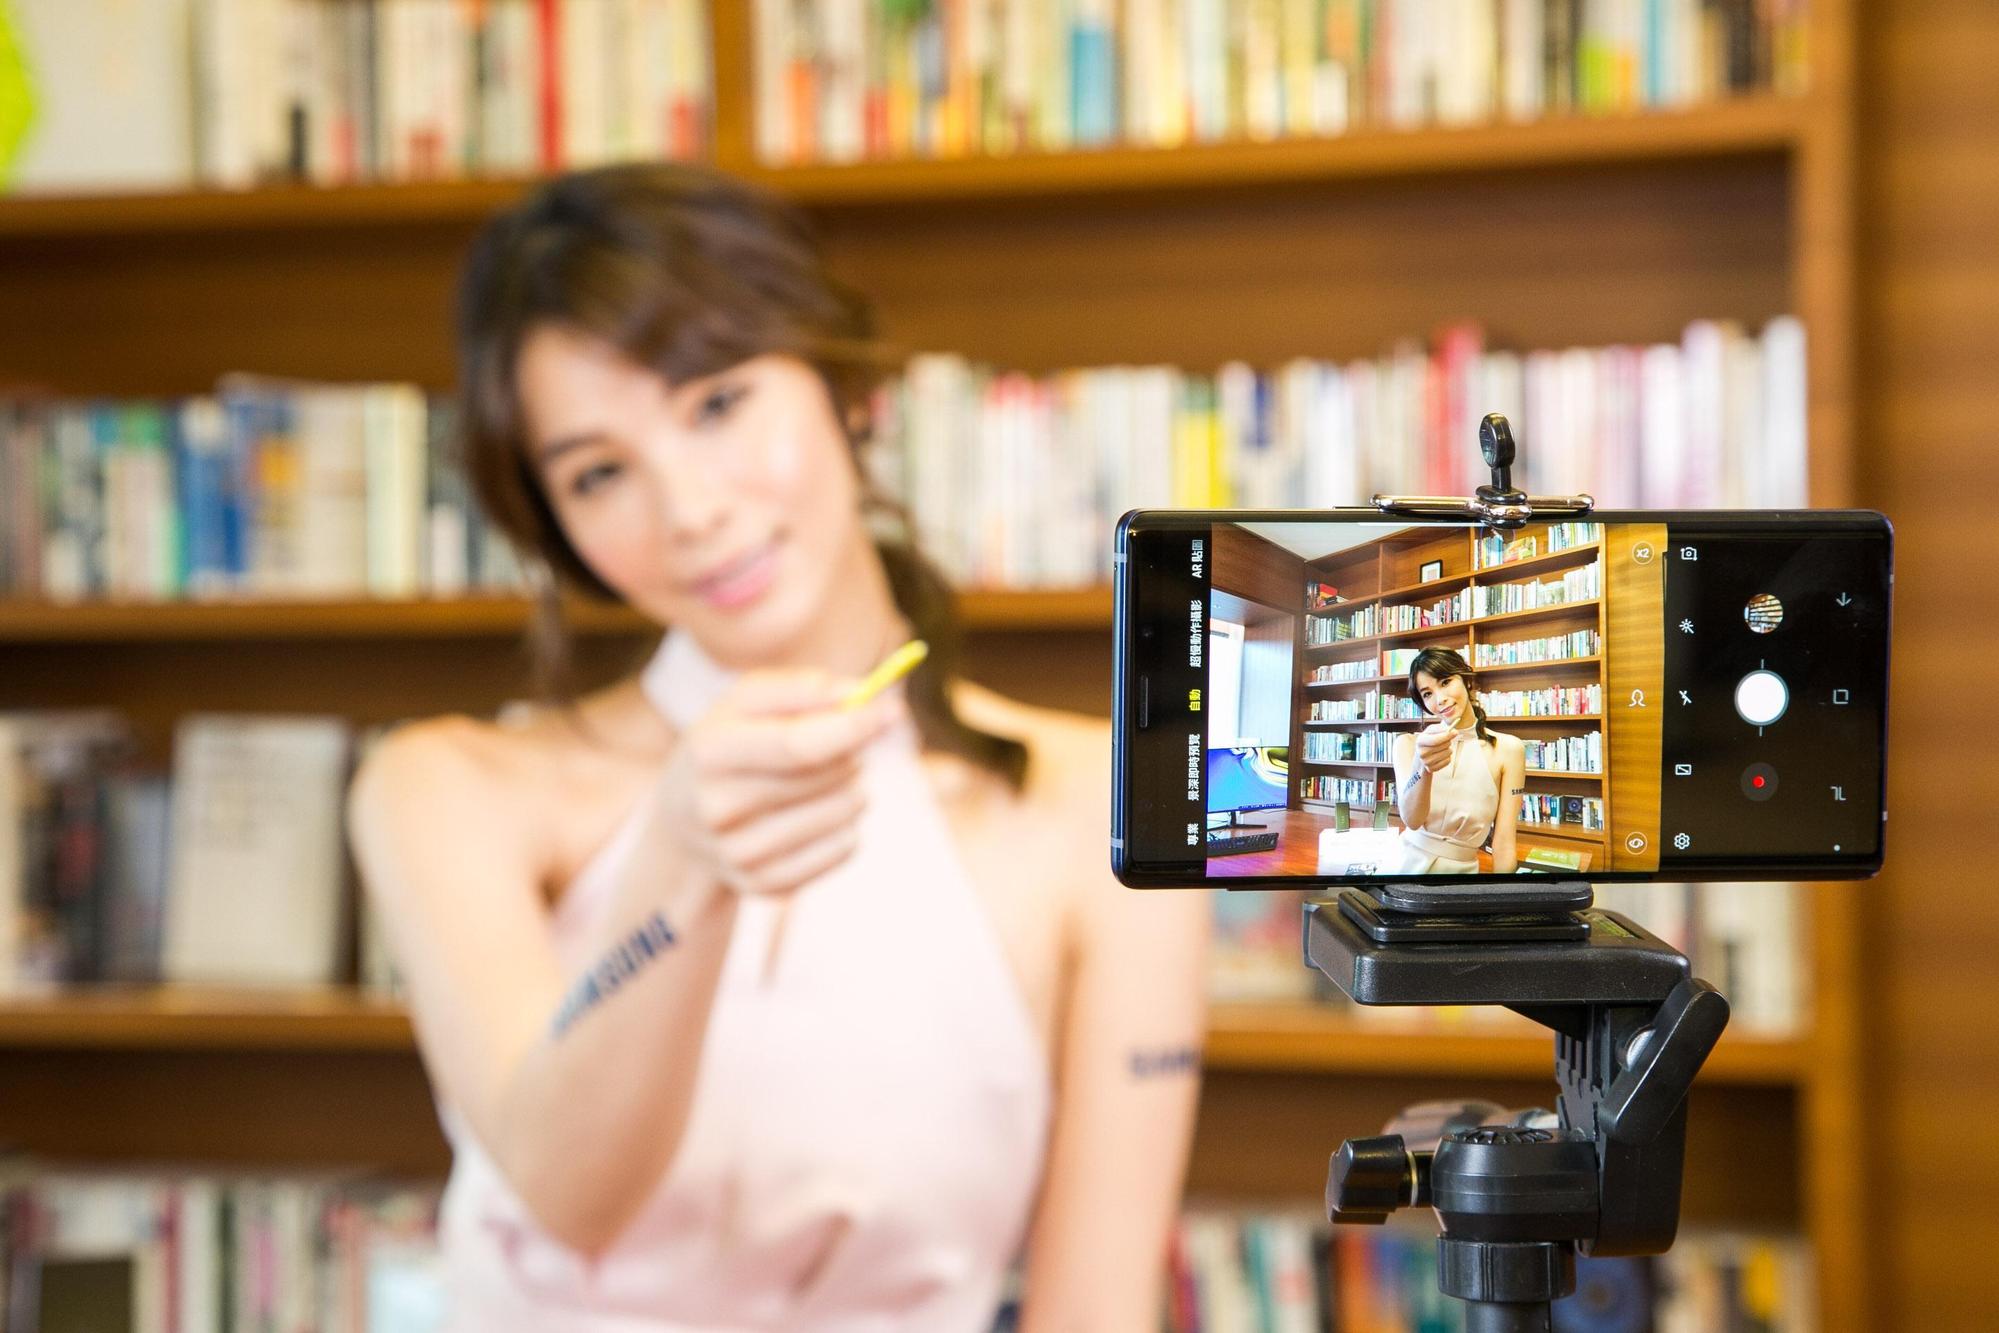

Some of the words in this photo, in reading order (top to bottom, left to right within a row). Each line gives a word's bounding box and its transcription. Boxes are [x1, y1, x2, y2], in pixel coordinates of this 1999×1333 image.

[1191, 539, 1203, 562] 貼圖
[1191, 563, 1203, 579] AR
[1189, 599, 1203, 668] 超慢動作攝影
[1188, 688, 1202, 712] 自動
[1187, 733, 1201, 802] 景深即時預覽
[1187, 822, 1199, 846] 專業
